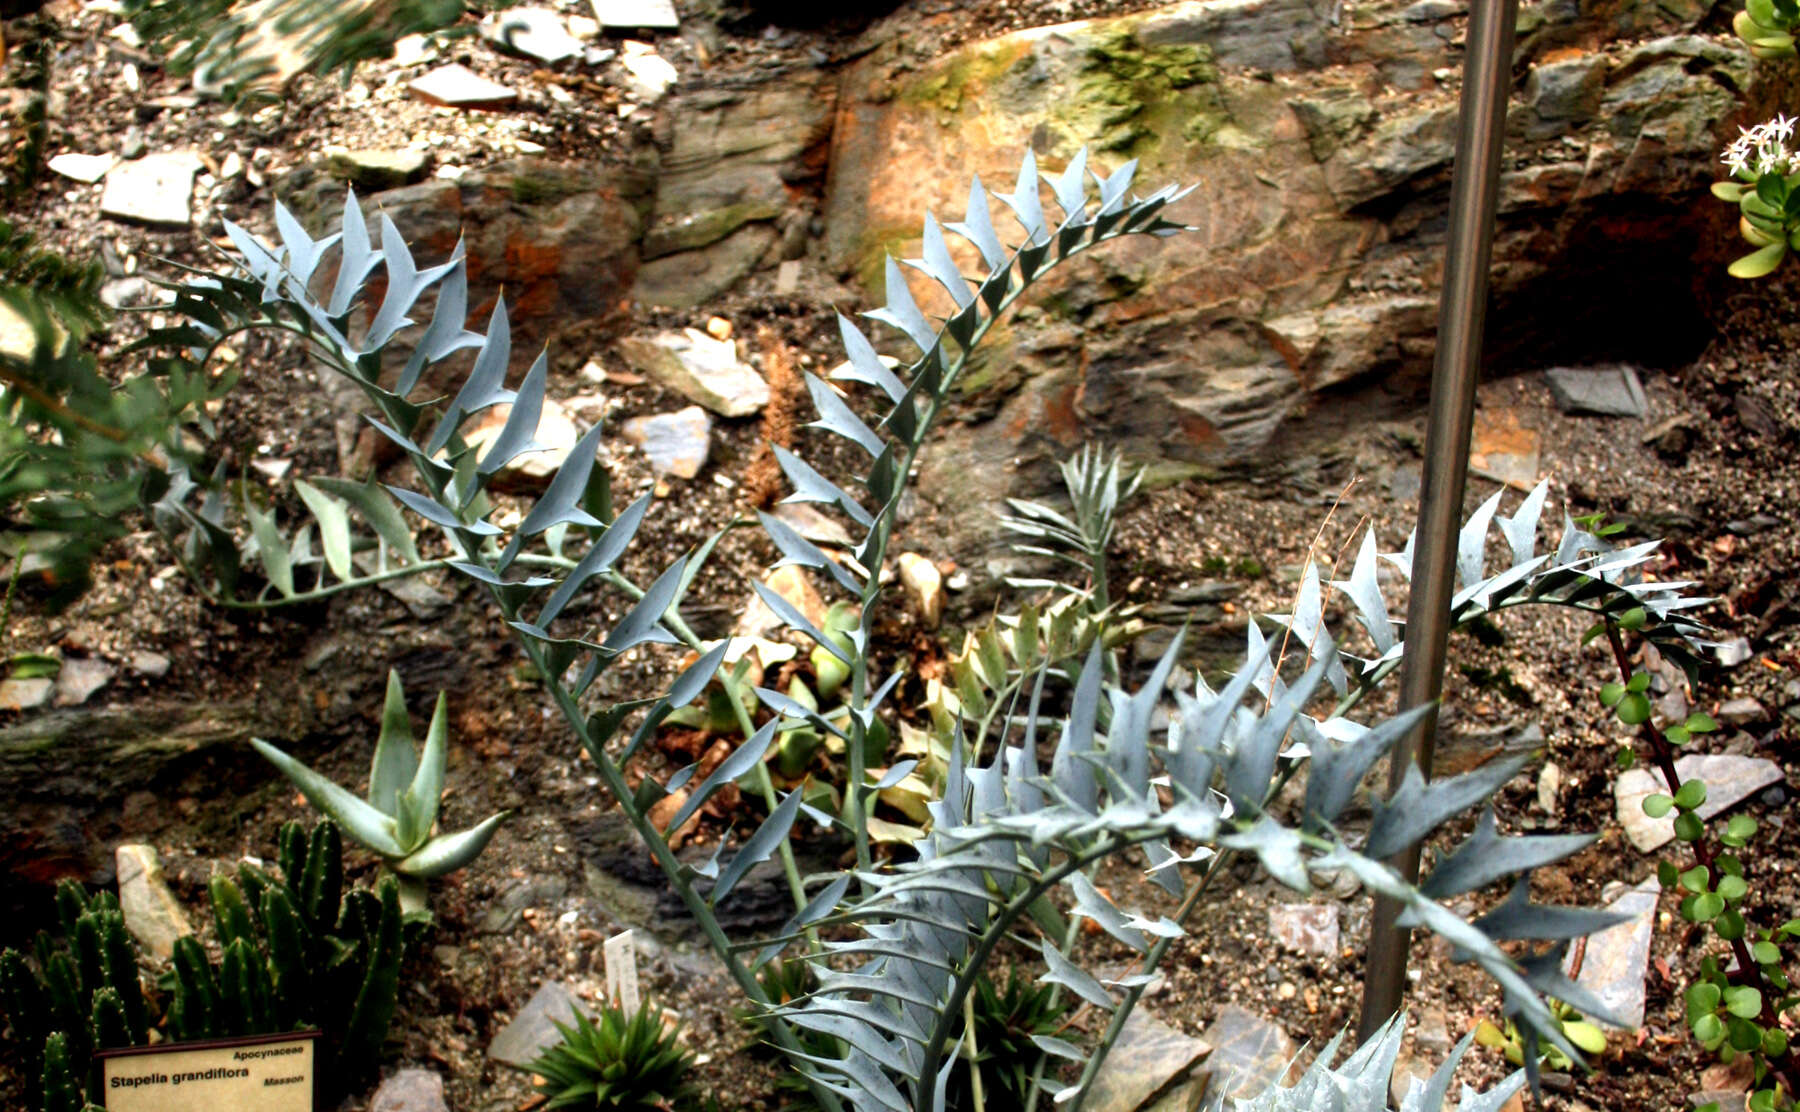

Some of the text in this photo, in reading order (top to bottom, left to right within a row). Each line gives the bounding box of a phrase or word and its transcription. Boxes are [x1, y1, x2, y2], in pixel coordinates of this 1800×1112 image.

[233, 1045, 304, 1061] Apocynaceae
[110, 1066, 249, 1089] Stapelia grandiflora
[263, 1075, 304, 1087] Masson
